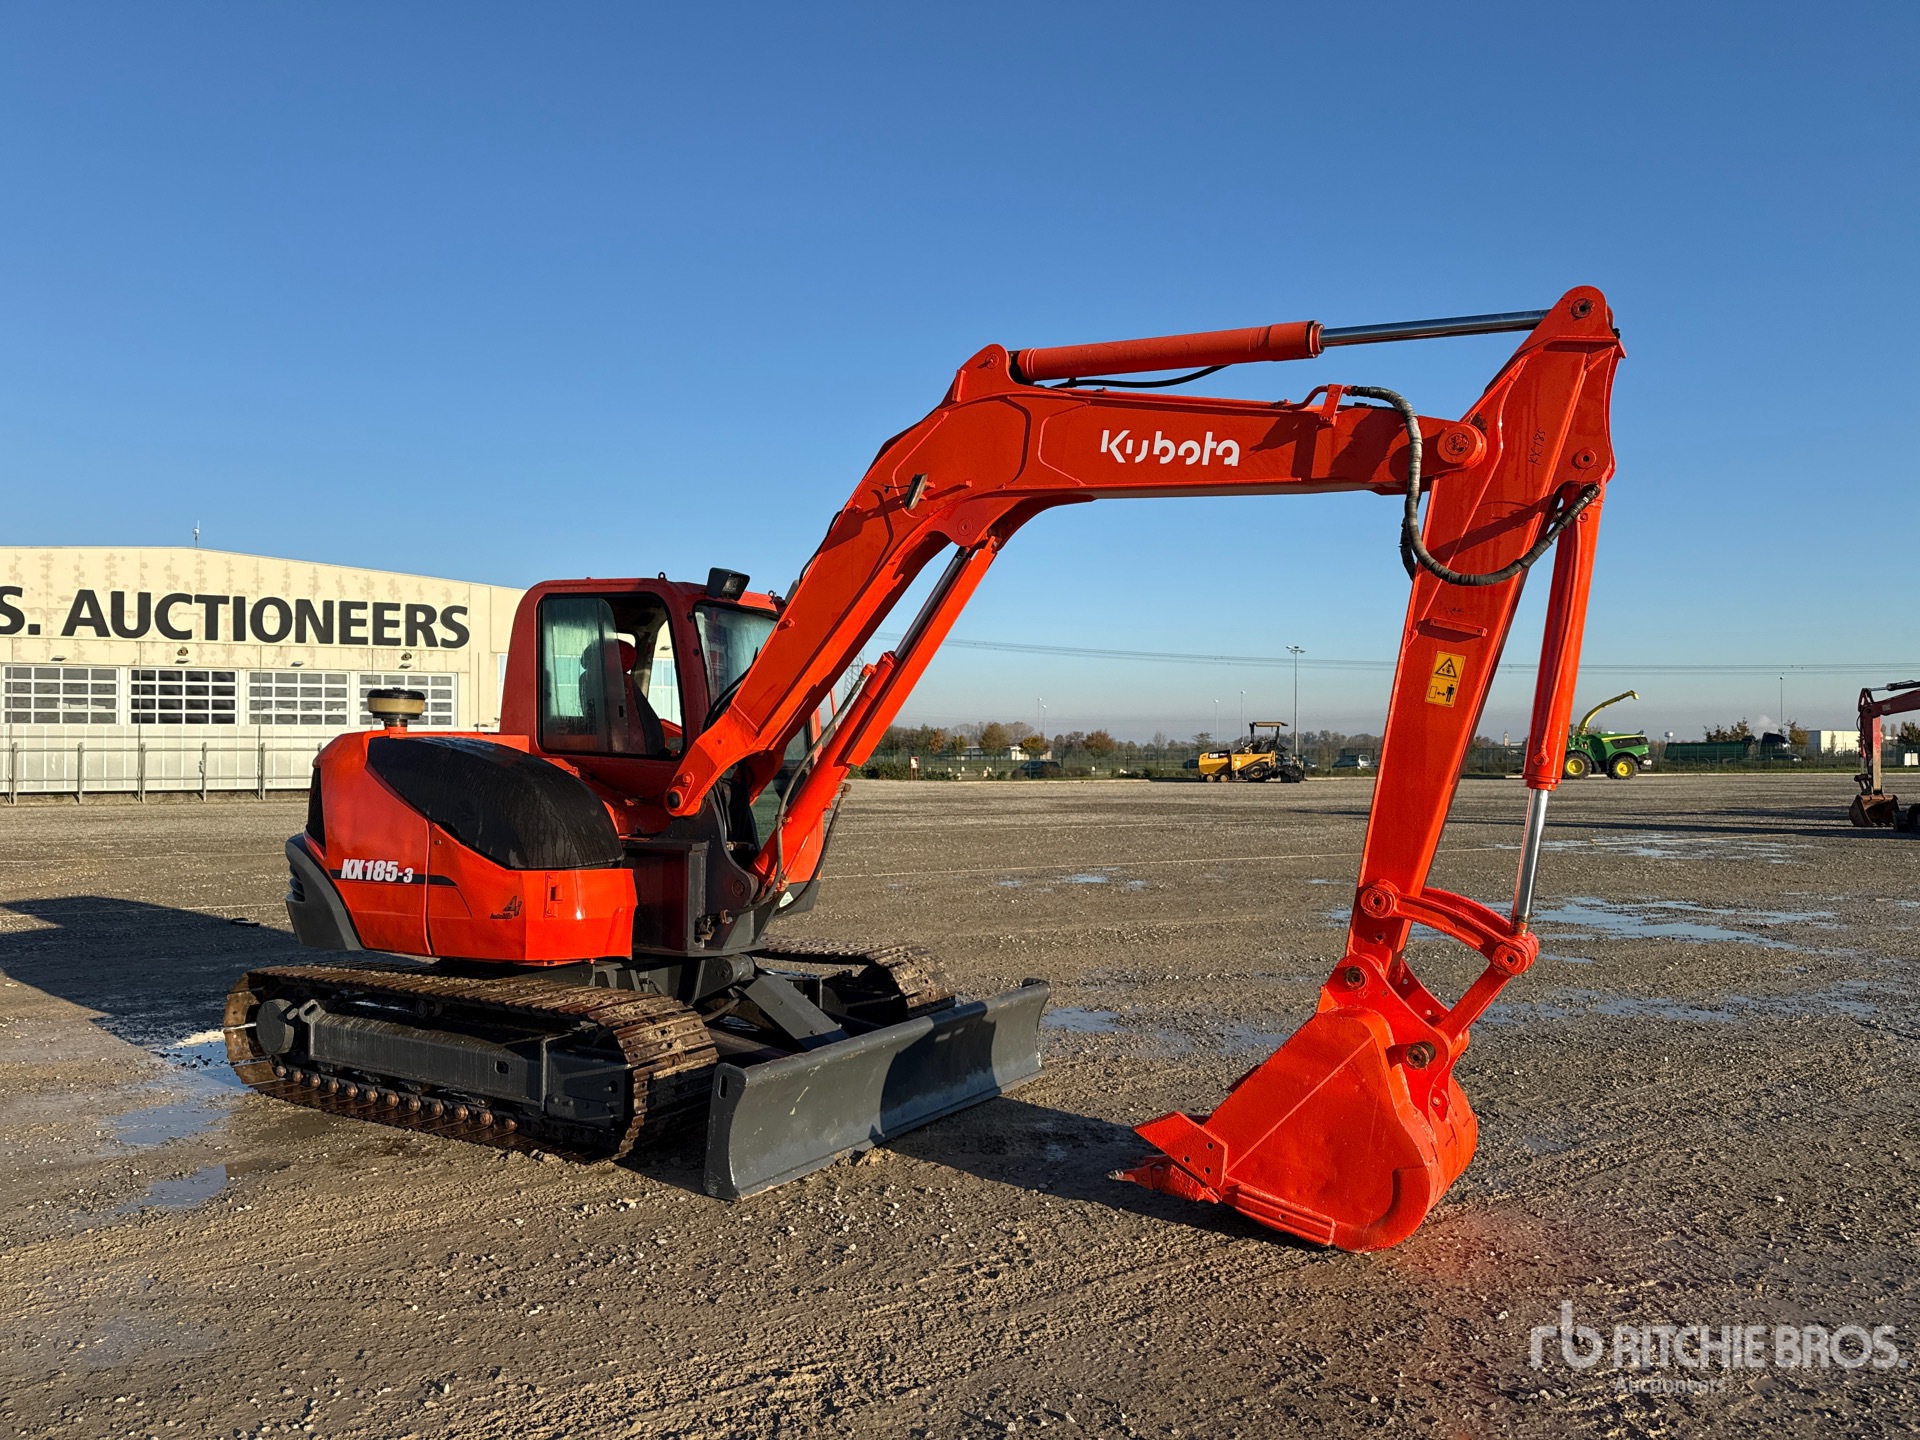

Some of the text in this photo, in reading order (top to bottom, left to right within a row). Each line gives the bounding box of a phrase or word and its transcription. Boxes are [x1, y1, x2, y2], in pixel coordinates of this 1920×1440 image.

[1100, 429, 1240, 467] Kubota
[60, 588, 470, 649] AUCTIONEERS
[340, 858, 414, 884] KX185-3
